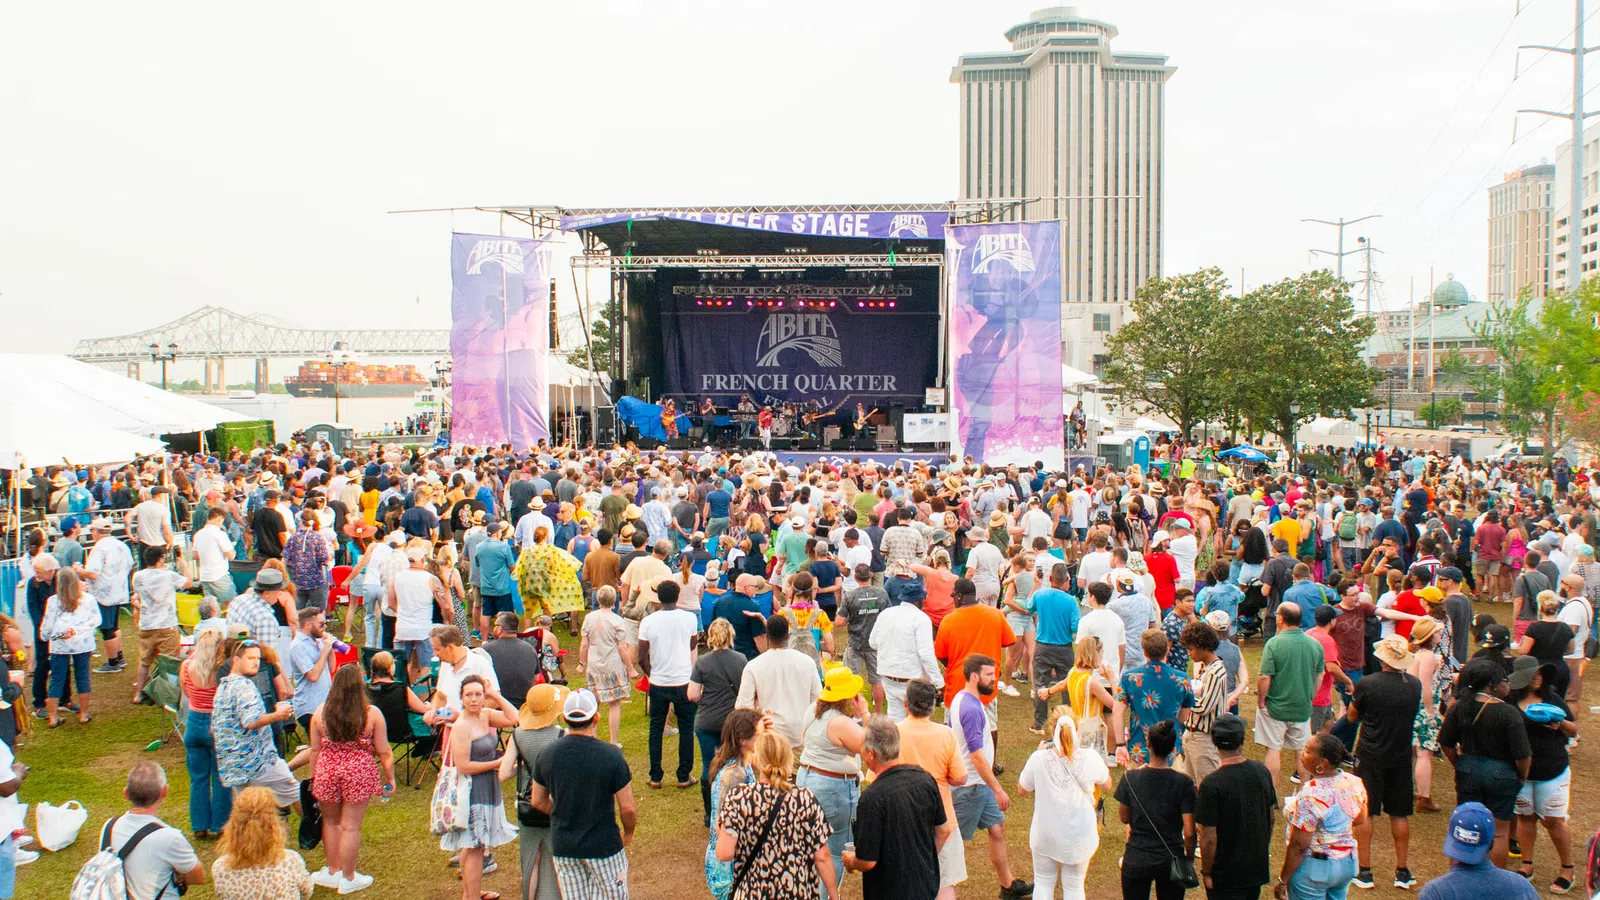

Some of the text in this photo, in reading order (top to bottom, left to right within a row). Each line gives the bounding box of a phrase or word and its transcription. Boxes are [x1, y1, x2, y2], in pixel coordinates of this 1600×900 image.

[791, 214, 870, 237] STAGE
[890, 214, 926, 231] ABITA
[466, 240, 523, 270] ABITA
[972, 233, 1031, 269] ABITA
[756, 314, 838, 360] ABITA
[701, 373, 898, 393] FRENCH QUARTER
